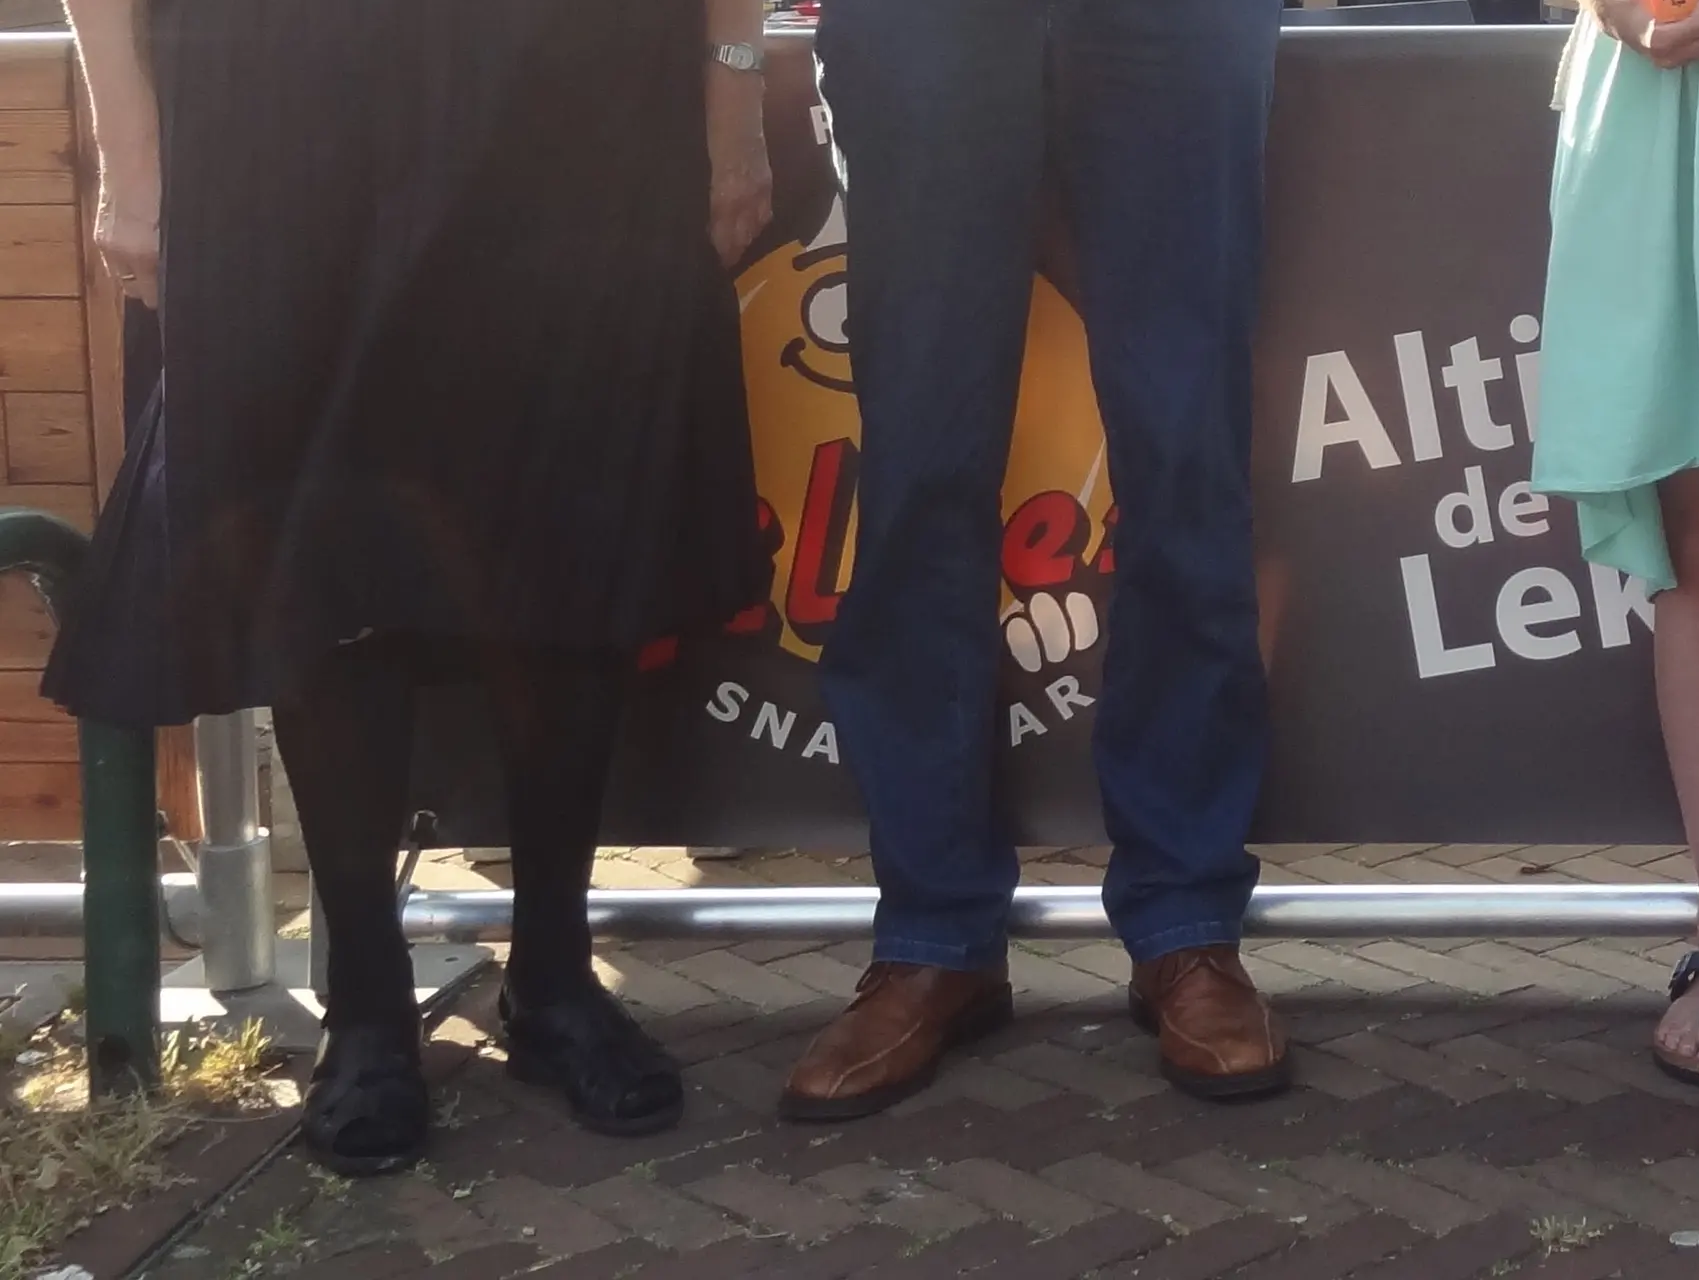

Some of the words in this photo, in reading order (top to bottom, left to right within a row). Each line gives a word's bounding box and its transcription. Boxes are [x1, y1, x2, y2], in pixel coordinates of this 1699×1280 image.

[1291, 314, 1543, 483] Alti
[1434, 465, 1551, 549] de
[1400, 553, 1656, 679] Lek
[705, 675, 1096, 764] SNAAR
